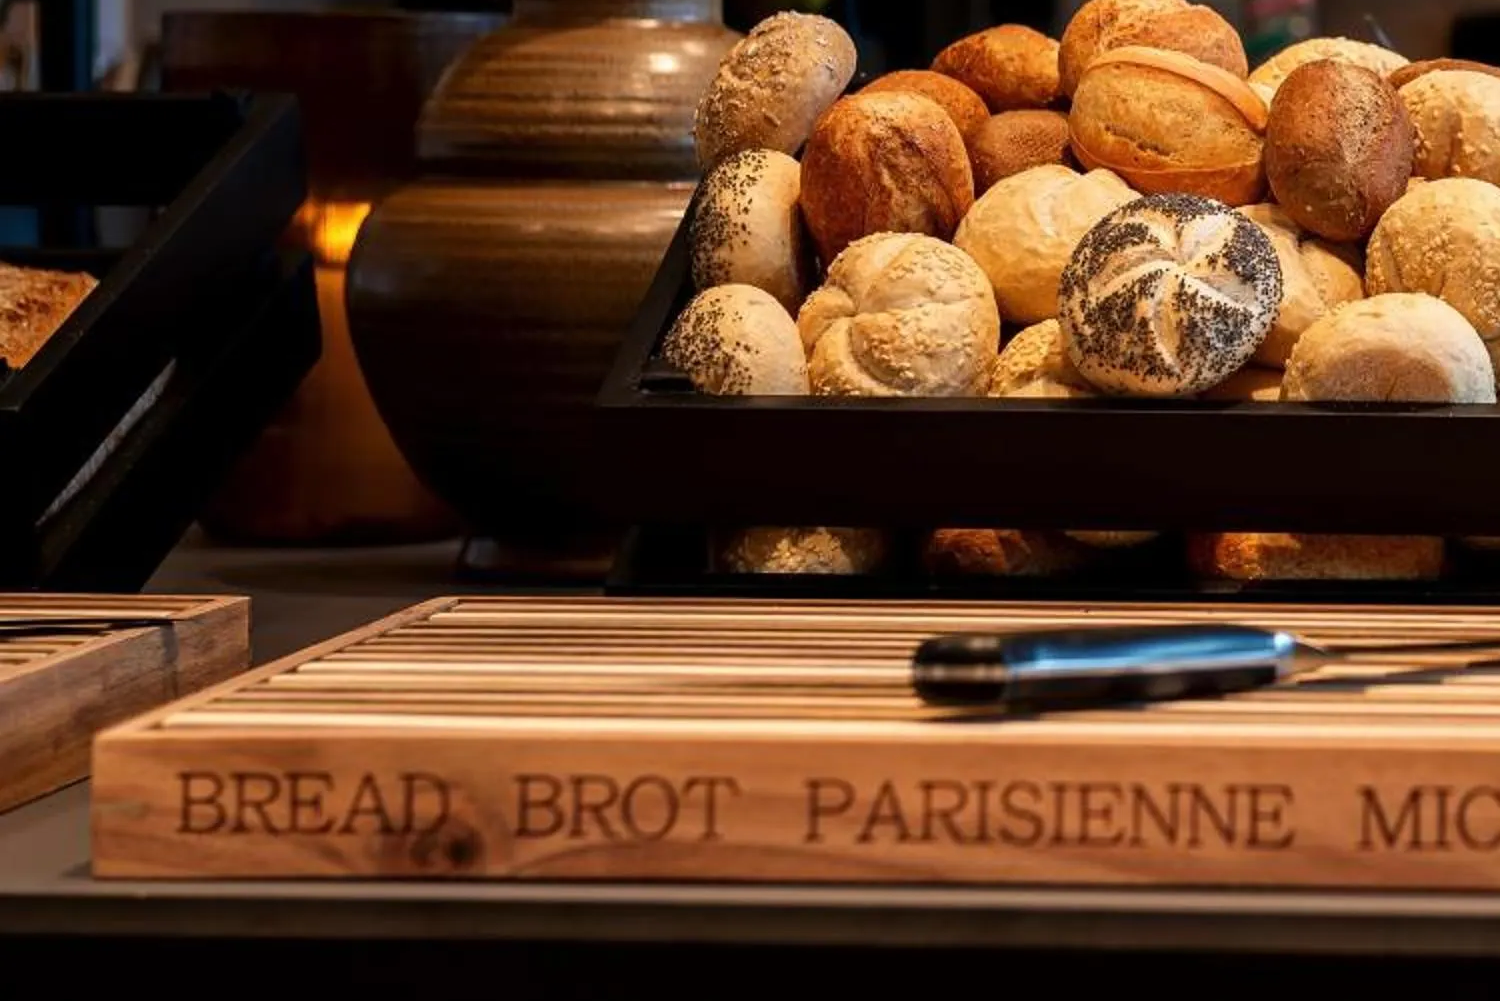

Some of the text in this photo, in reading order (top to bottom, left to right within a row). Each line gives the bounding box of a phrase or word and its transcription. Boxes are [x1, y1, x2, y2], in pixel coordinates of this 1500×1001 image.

[176, 770, 454, 838] BREAD
[513, 774, 741, 841] BROT
[803, 777, 1296, 850] PARISIENNE
